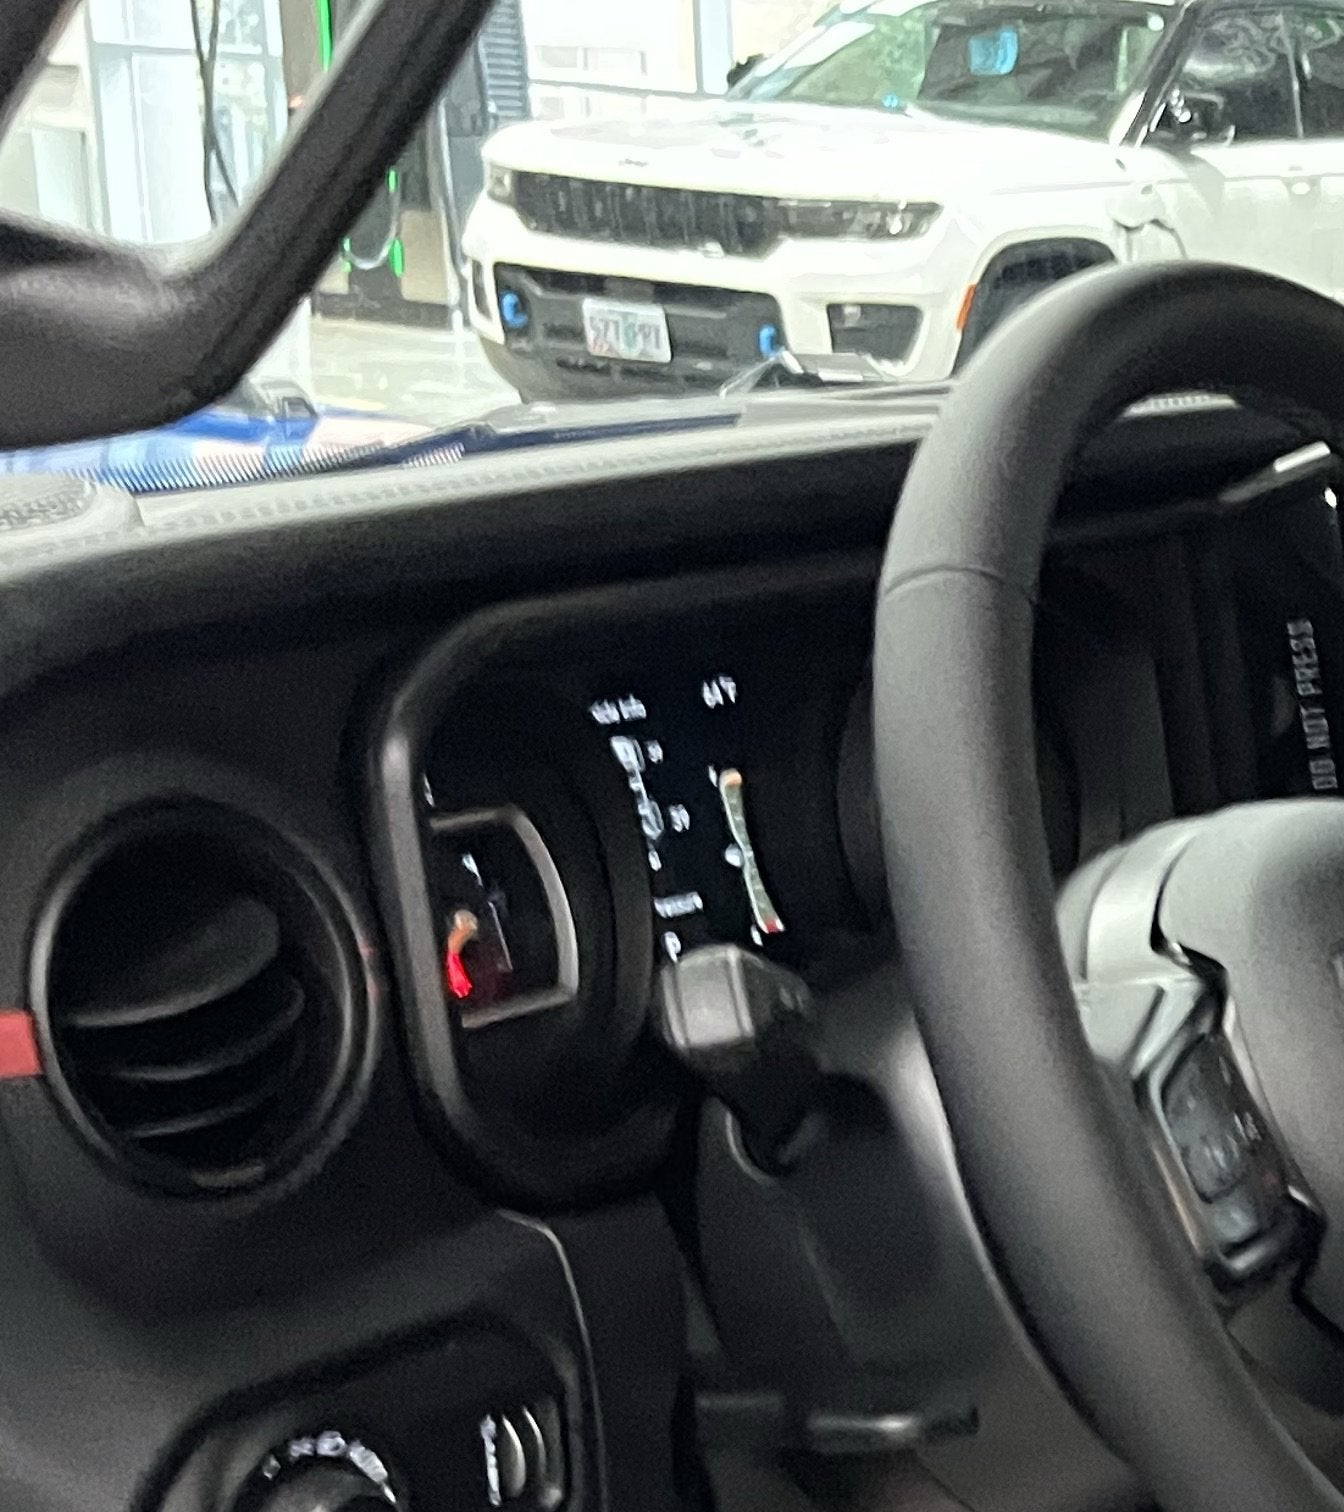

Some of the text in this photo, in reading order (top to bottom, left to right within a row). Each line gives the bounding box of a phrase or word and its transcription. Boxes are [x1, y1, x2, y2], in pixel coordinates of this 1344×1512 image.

[1286, 618, 1338, 790] DO NOT PRESS
